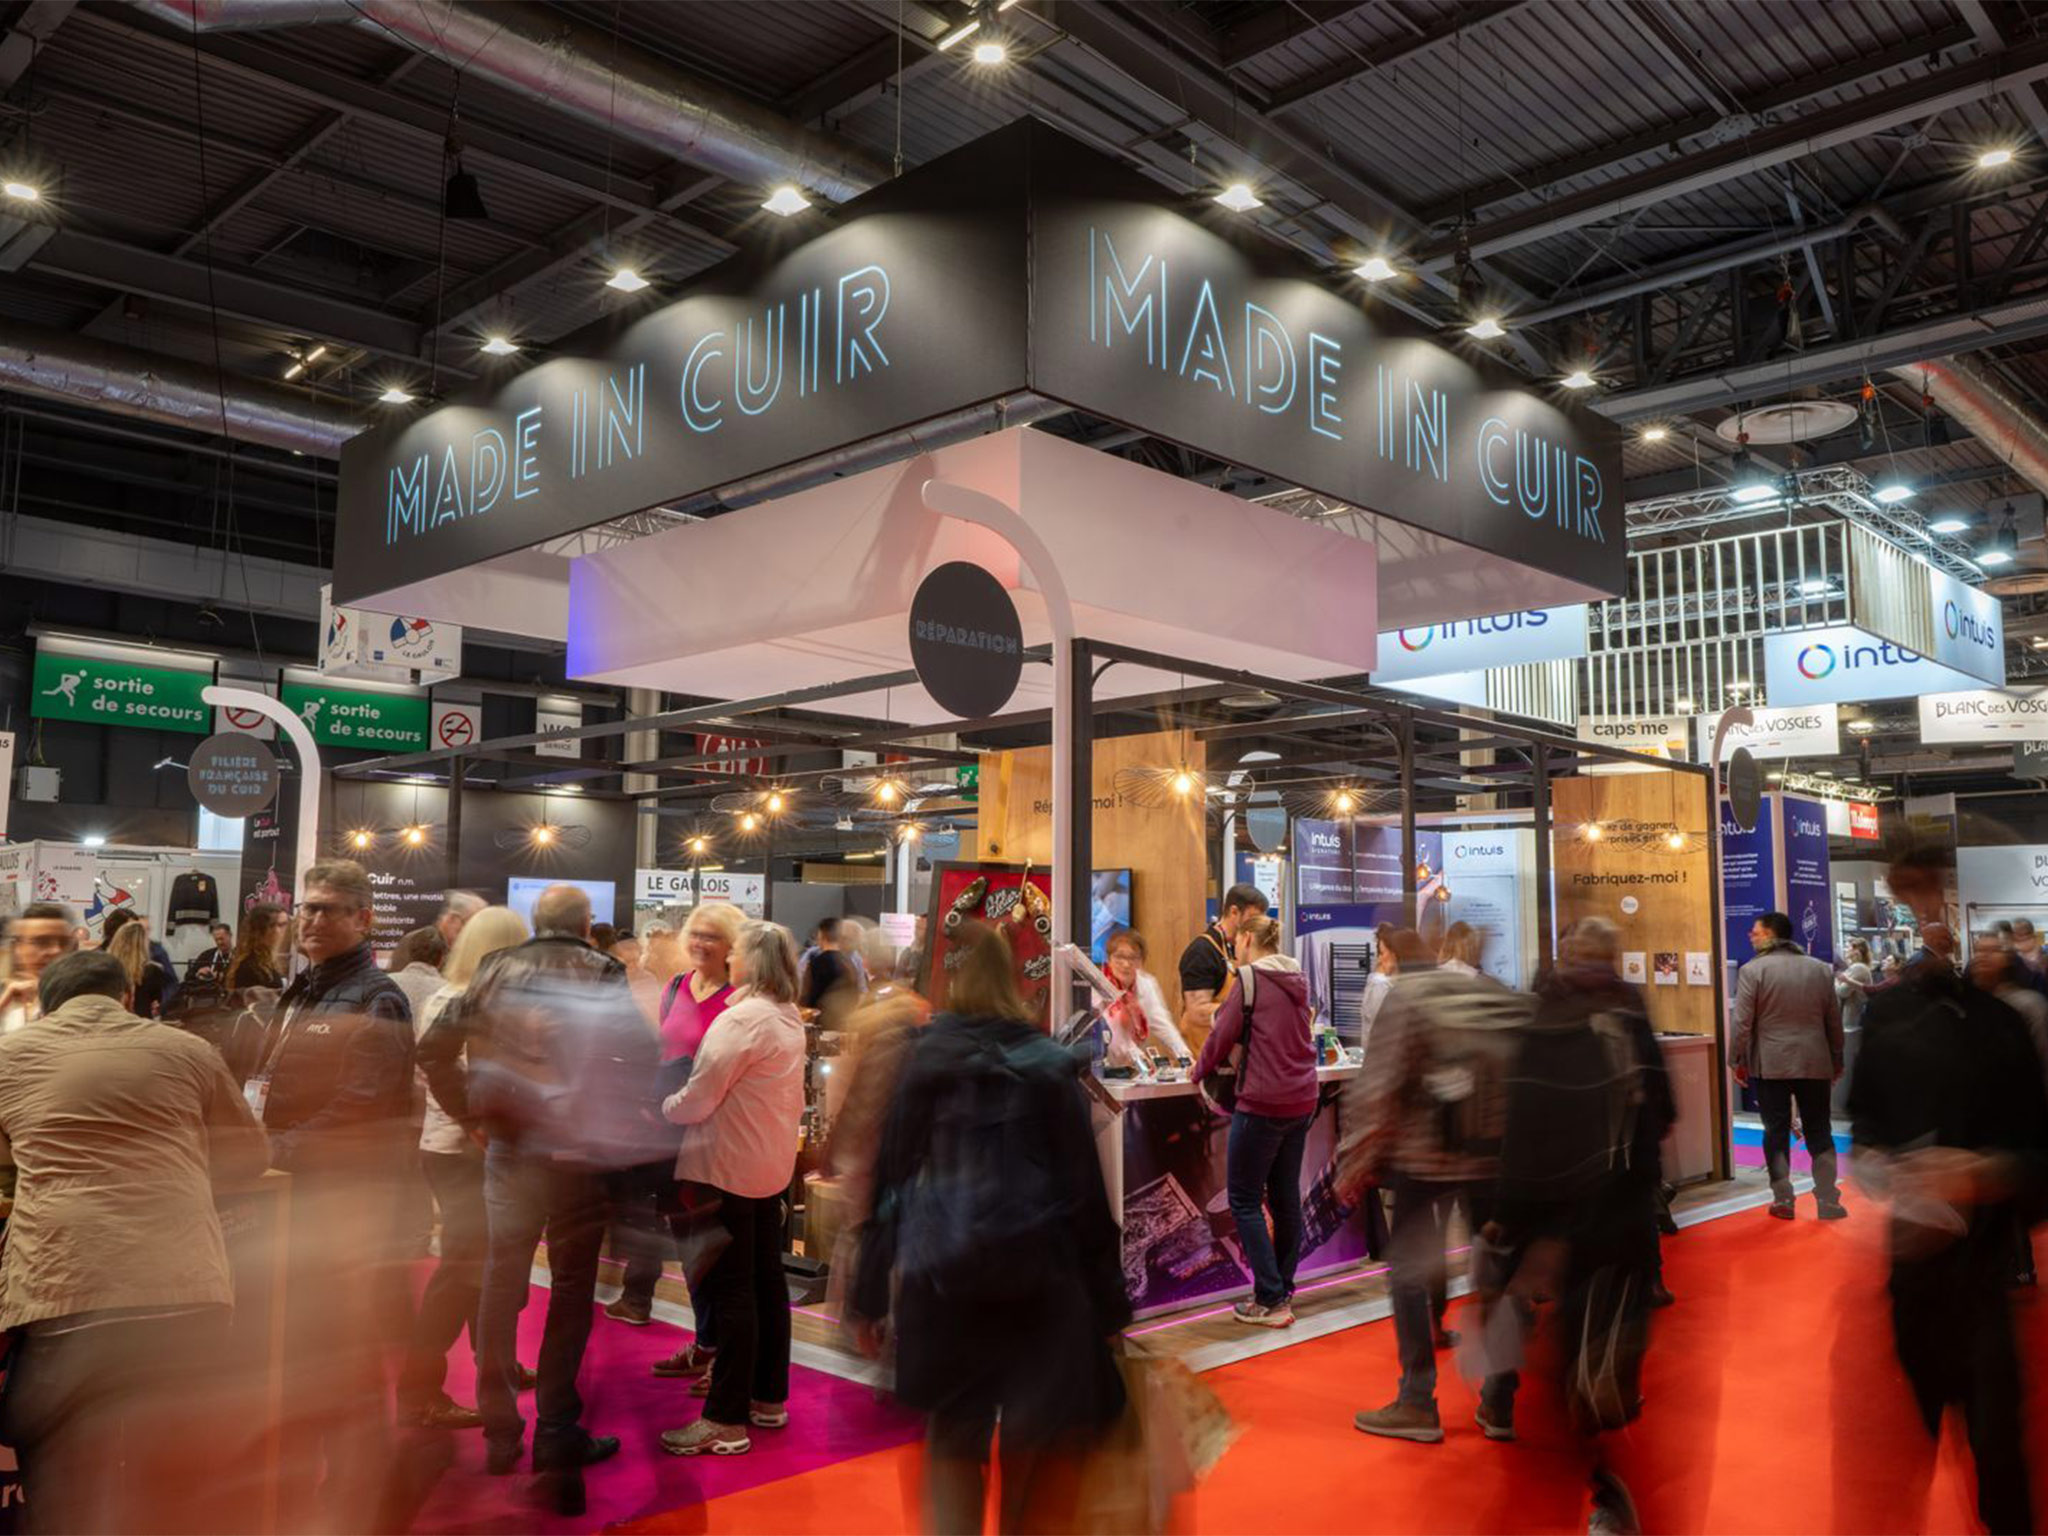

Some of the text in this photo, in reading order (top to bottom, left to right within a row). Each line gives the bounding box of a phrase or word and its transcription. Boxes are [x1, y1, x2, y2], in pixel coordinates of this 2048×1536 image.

[1090, 226, 1606, 543] MADE IN CUIR
[386, 263, 890, 545] MADE IN CUIR
[1441, 609, 1549, 640] intuis
[1958, 608, 1996, 650] intuis
[915, 619, 1019, 655] RÉPARATION
[1844, 640, 1922, 670] intu
[92, 676, 155, 696] sortie
[91, 694, 204, 722] de secours
[329, 701, 381, 720] sortie
[1935, 700, 1989, 718] BLANC
[2006, 700, 2048, 714] VOSG
[329, 719, 422, 743] de secours
[1765, 715, 1822, 732] VOSGES
[210, 755, 258, 768] FILIÈRE
[198, 769, 269, 784] FRANÇAISE
[207, 783, 263, 796] DU CUIR
[1311, 832, 1341, 848] intuis
[1468, 844, 1504, 856] intuis
[2034, 855, 2048, 869] BL
[367, 872, 397, 885] Cuir
[647, 876, 664, 890] LE
[1573, 870, 1688, 886] Fabriquez-moi !
[2031, 875, 2048, 887] VO
[403, 893, 418, 901] une
[420, 891, 445, 901] matiè
[372, 903, 397, 913] Noble
[1309, 912, 1332, 921] intuis
